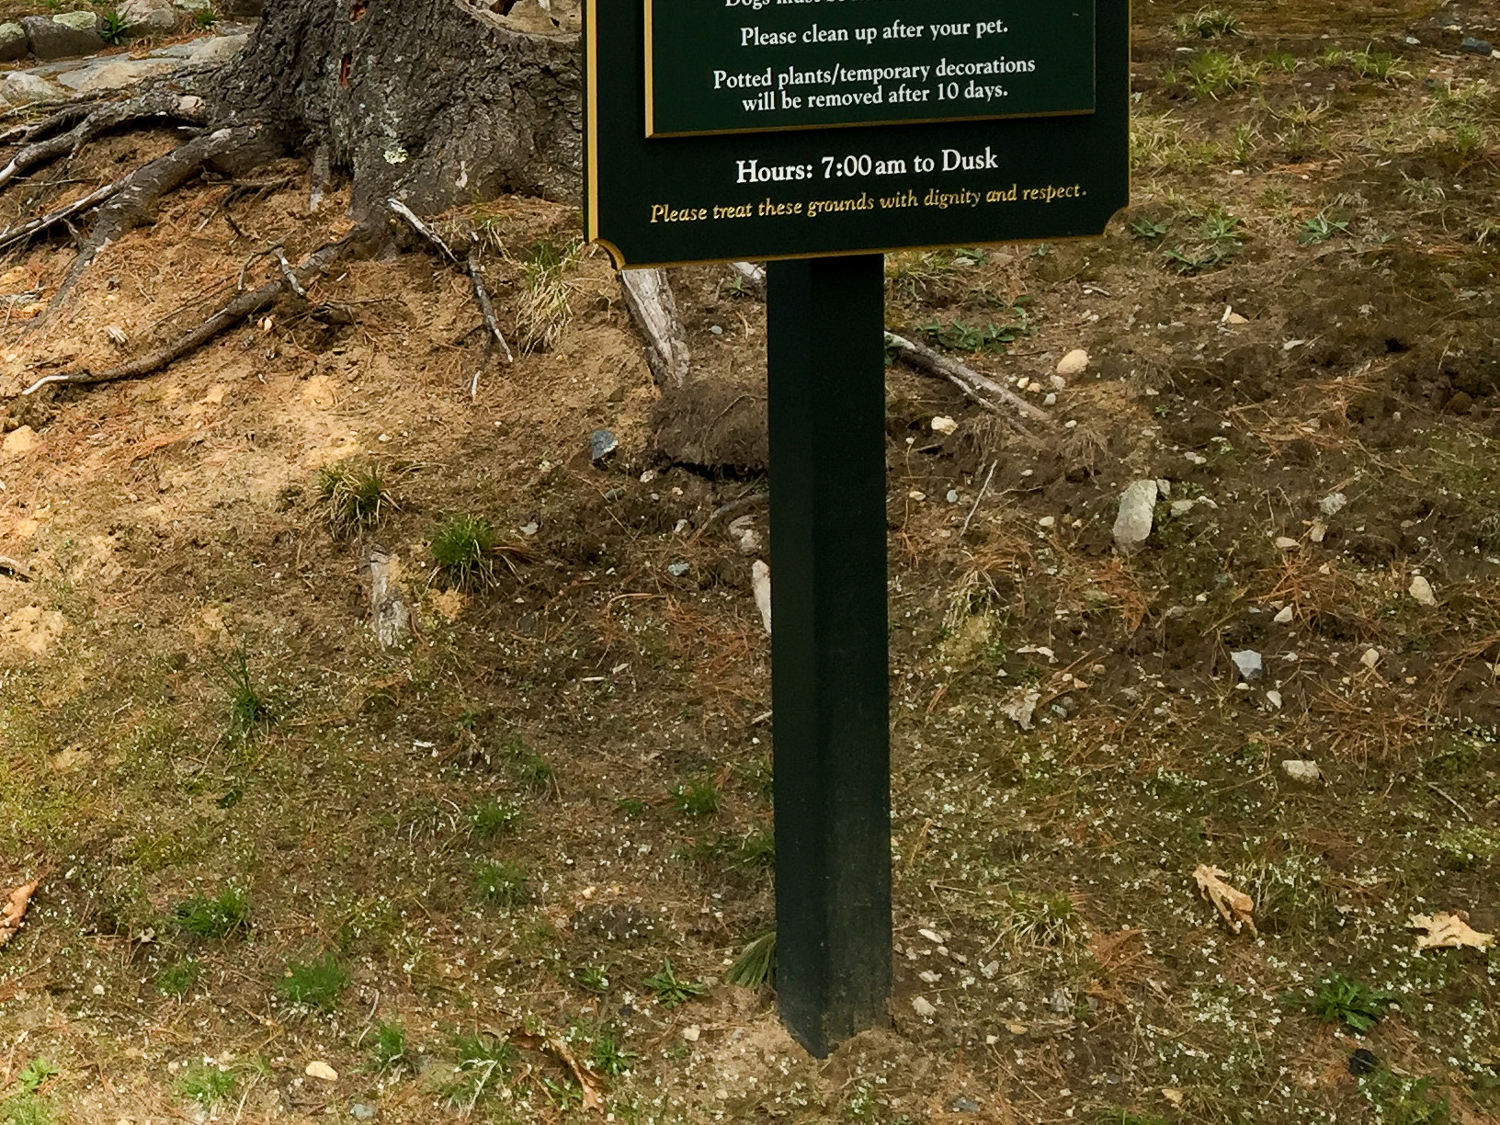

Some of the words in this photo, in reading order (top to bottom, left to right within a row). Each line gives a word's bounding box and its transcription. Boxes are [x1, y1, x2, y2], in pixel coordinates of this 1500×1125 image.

[739, 25, 798, 47] Please
[801, 23, 850, 44] clean
[854, 26, 878, 45] up
[882, 18, 925, 40] after
[929, 22, 972, 42] your
[975, 18, 1009, 40] pet.
[712, 66, 773, 90] Potted
[777, 62, 931, 91] plants/temporary
[934, 55, 1036, 78] decorations
[741, 90, 776, 112] will
[780, 89, 803, 110] be
[807, 84, 884, 109] removed
[887, 82, 931, 104] after
[936, 81, 960, 101] 10
[963, 79, 1009, 103] days.
[735, 158, 814, 184] Hours:
[912, 154, 936, 174] to
[940, 145, 999, 172] Dusk
[649, 203, 708, 224] Please
[712, 202, 754, 220] treat
[757, 197, 803, 217] these
[806, 191, 875, 218] grounds
[879, 188, 919, 209] with
[923, 187, 982, 210] dignity
[985, 182, 1018, 203] and
[1021, 183, 1087, 204] respect.
